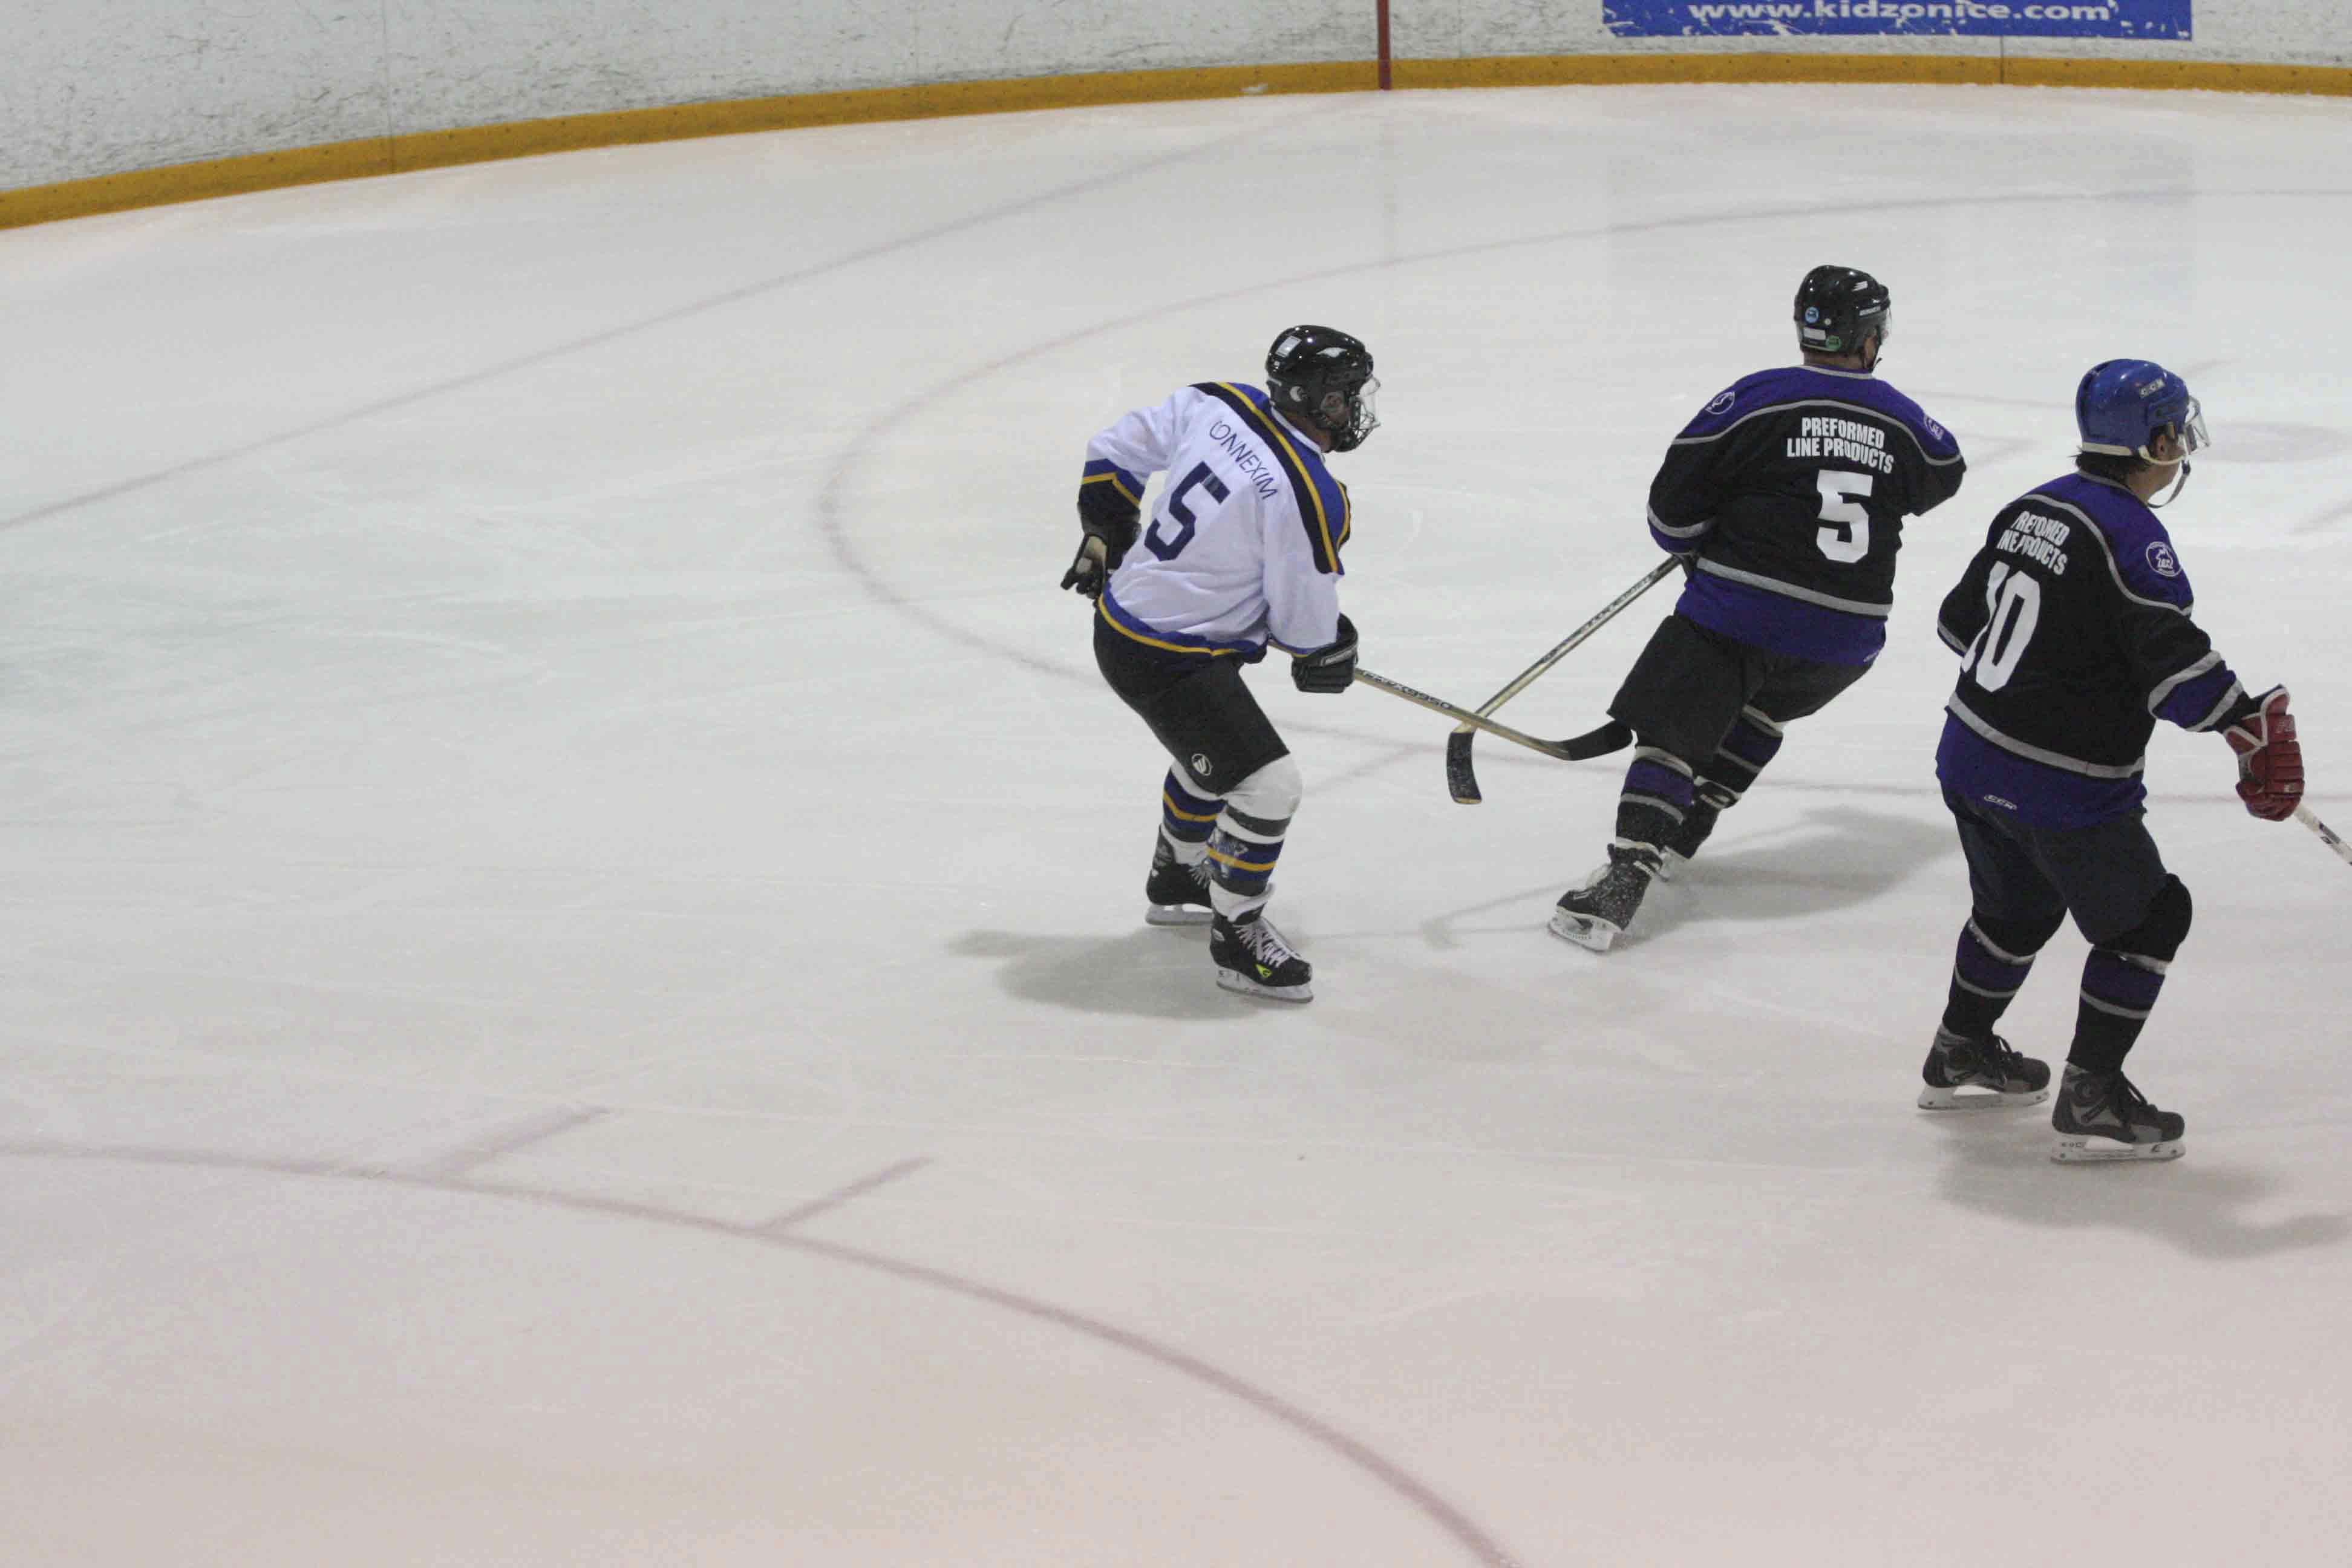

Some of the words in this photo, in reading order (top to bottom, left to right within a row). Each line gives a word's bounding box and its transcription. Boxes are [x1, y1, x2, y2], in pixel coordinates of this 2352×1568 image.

[1688, 0, 2109, 20] www.kidzonice.com
[1786, 437, 1820, 457] LINE
[1823, 437, 1894, 474] PRODUCTS
[1802, 417, 1885, 449] PREFORMED
[1144, 460, 1231, 562] 5
[1815, 469, 1873, 564] 5
[1961, 560, 2041, 693] 10
